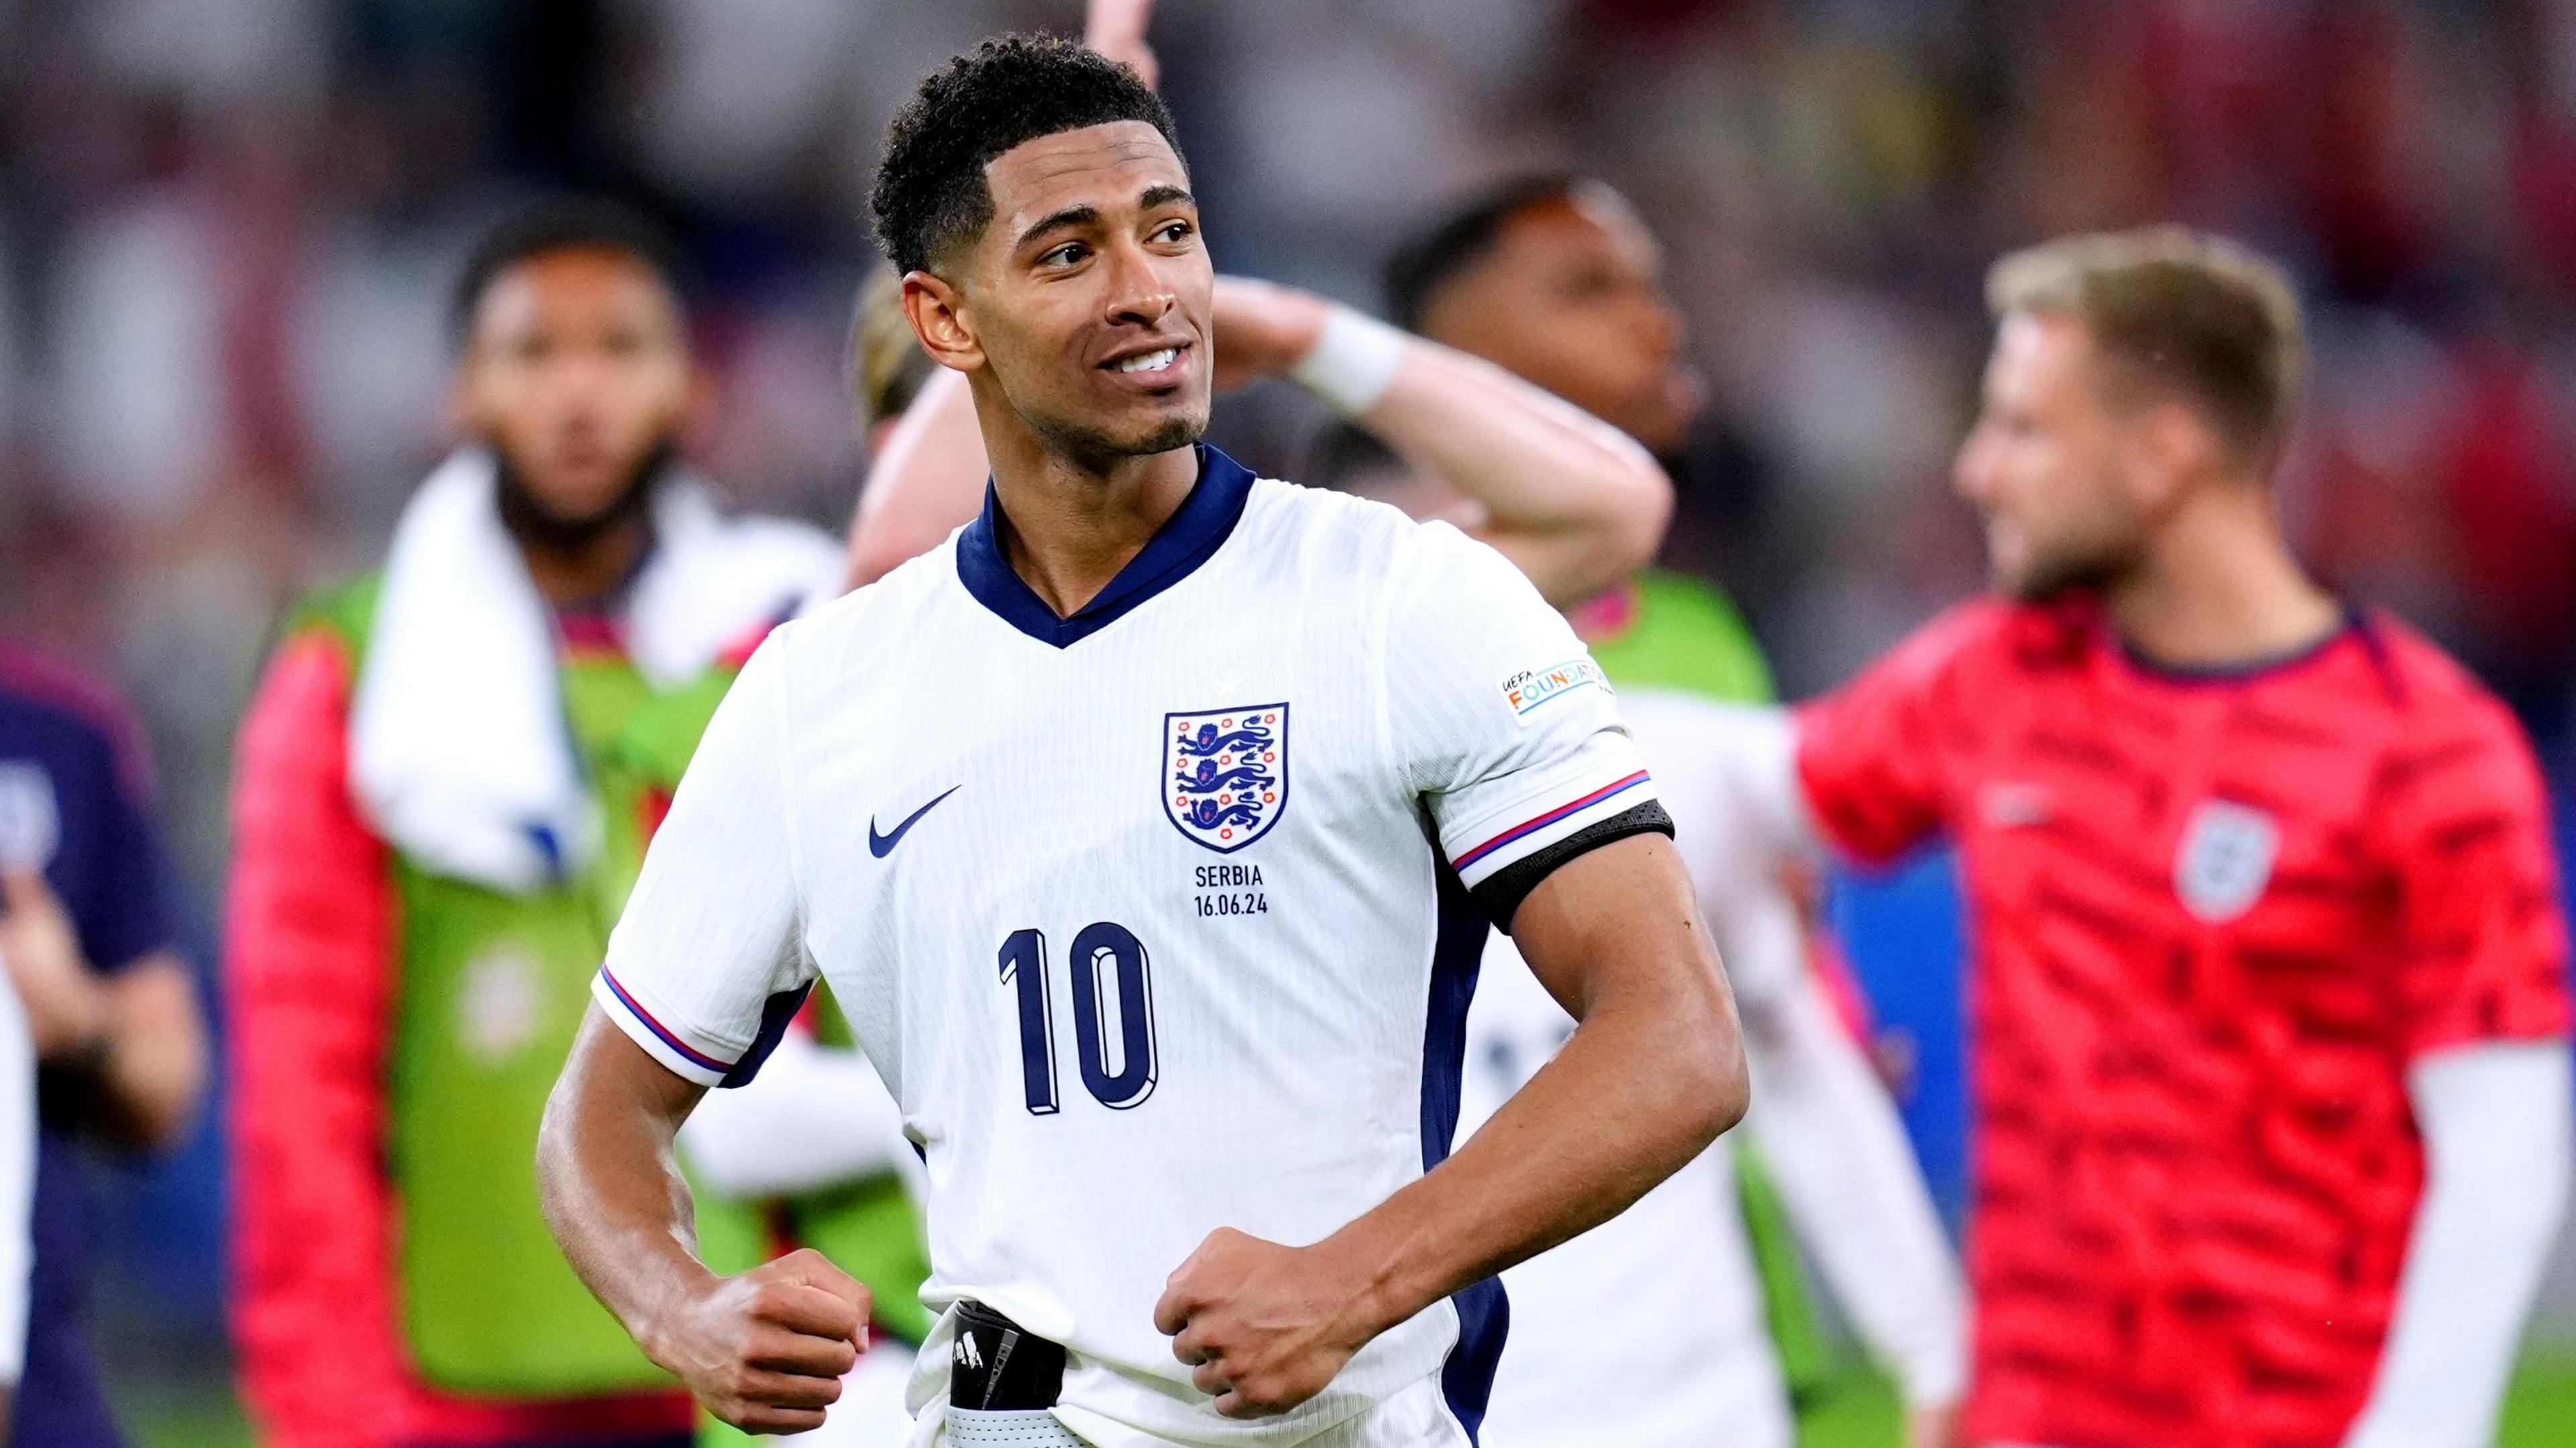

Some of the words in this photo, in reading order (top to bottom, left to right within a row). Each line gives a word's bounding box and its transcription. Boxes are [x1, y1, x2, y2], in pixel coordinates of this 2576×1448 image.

[1502, 670, 1534, 692] UEFA
[1195, 865, 1263, 887] SERBIA
[1194, 893, 1268, 917] 16.06.24
[998, 922, 1159, 1116] 10
